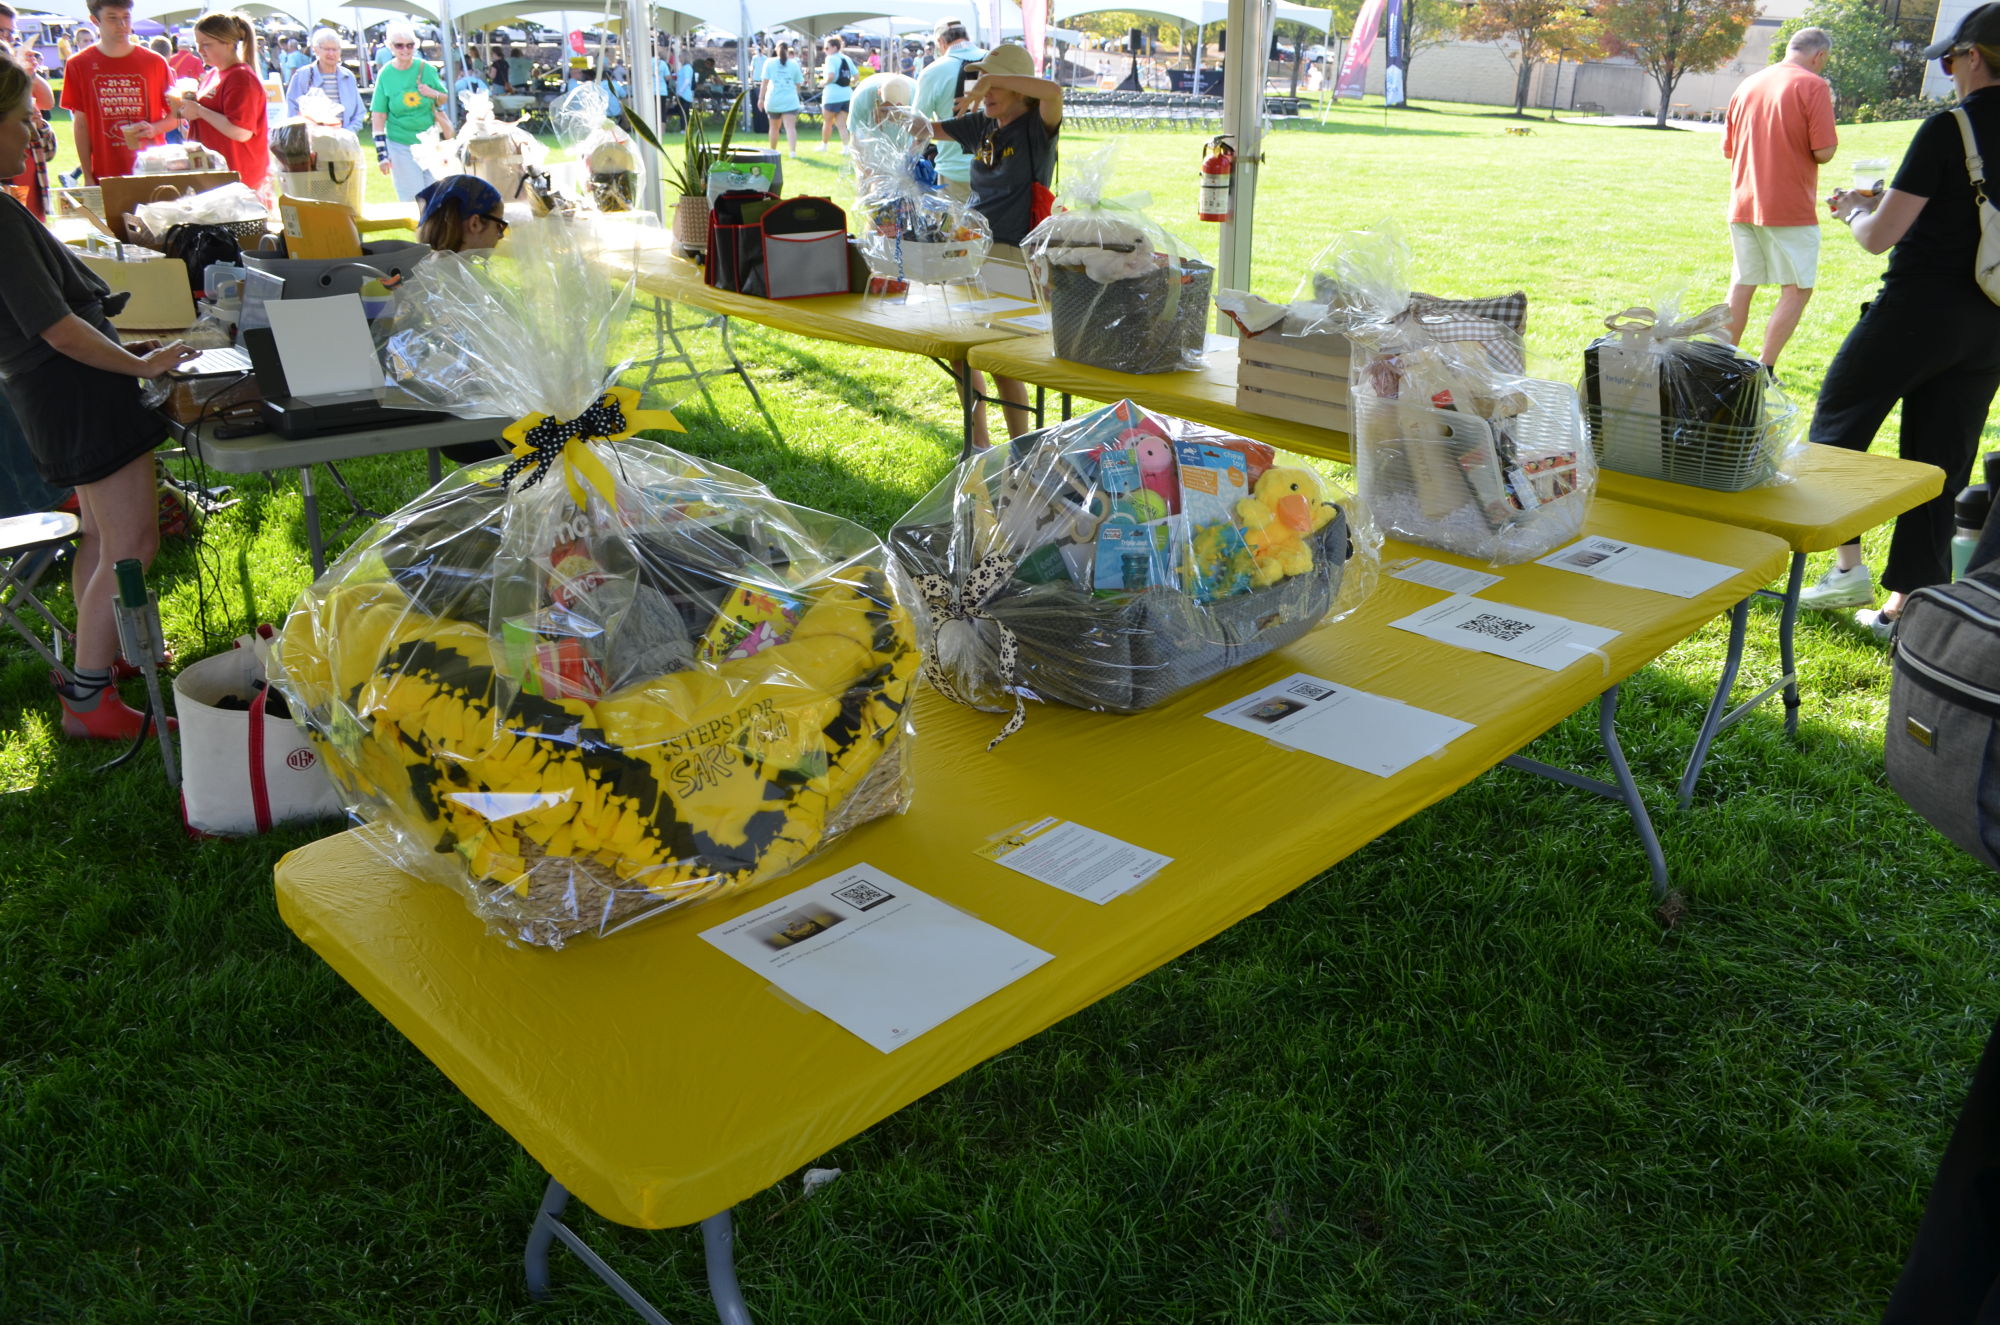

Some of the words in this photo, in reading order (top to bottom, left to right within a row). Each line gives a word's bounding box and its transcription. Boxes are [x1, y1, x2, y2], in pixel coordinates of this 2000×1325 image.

[1341, 47, 1357, 76] The
[108, 79, 131, 87] 21-22
[99, 87, 142, 97] COLLEGE
[99, 96, 145, 107] FOOTBALL
[103, 106, 143, 116] PLAYOFF
[1223, 451, 1244, 462] chew
[1232, 460, 1246, 470] toy
[1040, 551, 1061, 570] earth
[1044, 561, 1065, 579] rated
[662, 658, 685, 675] FOR
[670, 715, 734, 756] STEPS
[736, 698, 777, 727] FOR
[722, 927, 738, 935] Steps
[746, 913, 770, 924] Sarcoma
[769, 905, 788, 914] Basket
